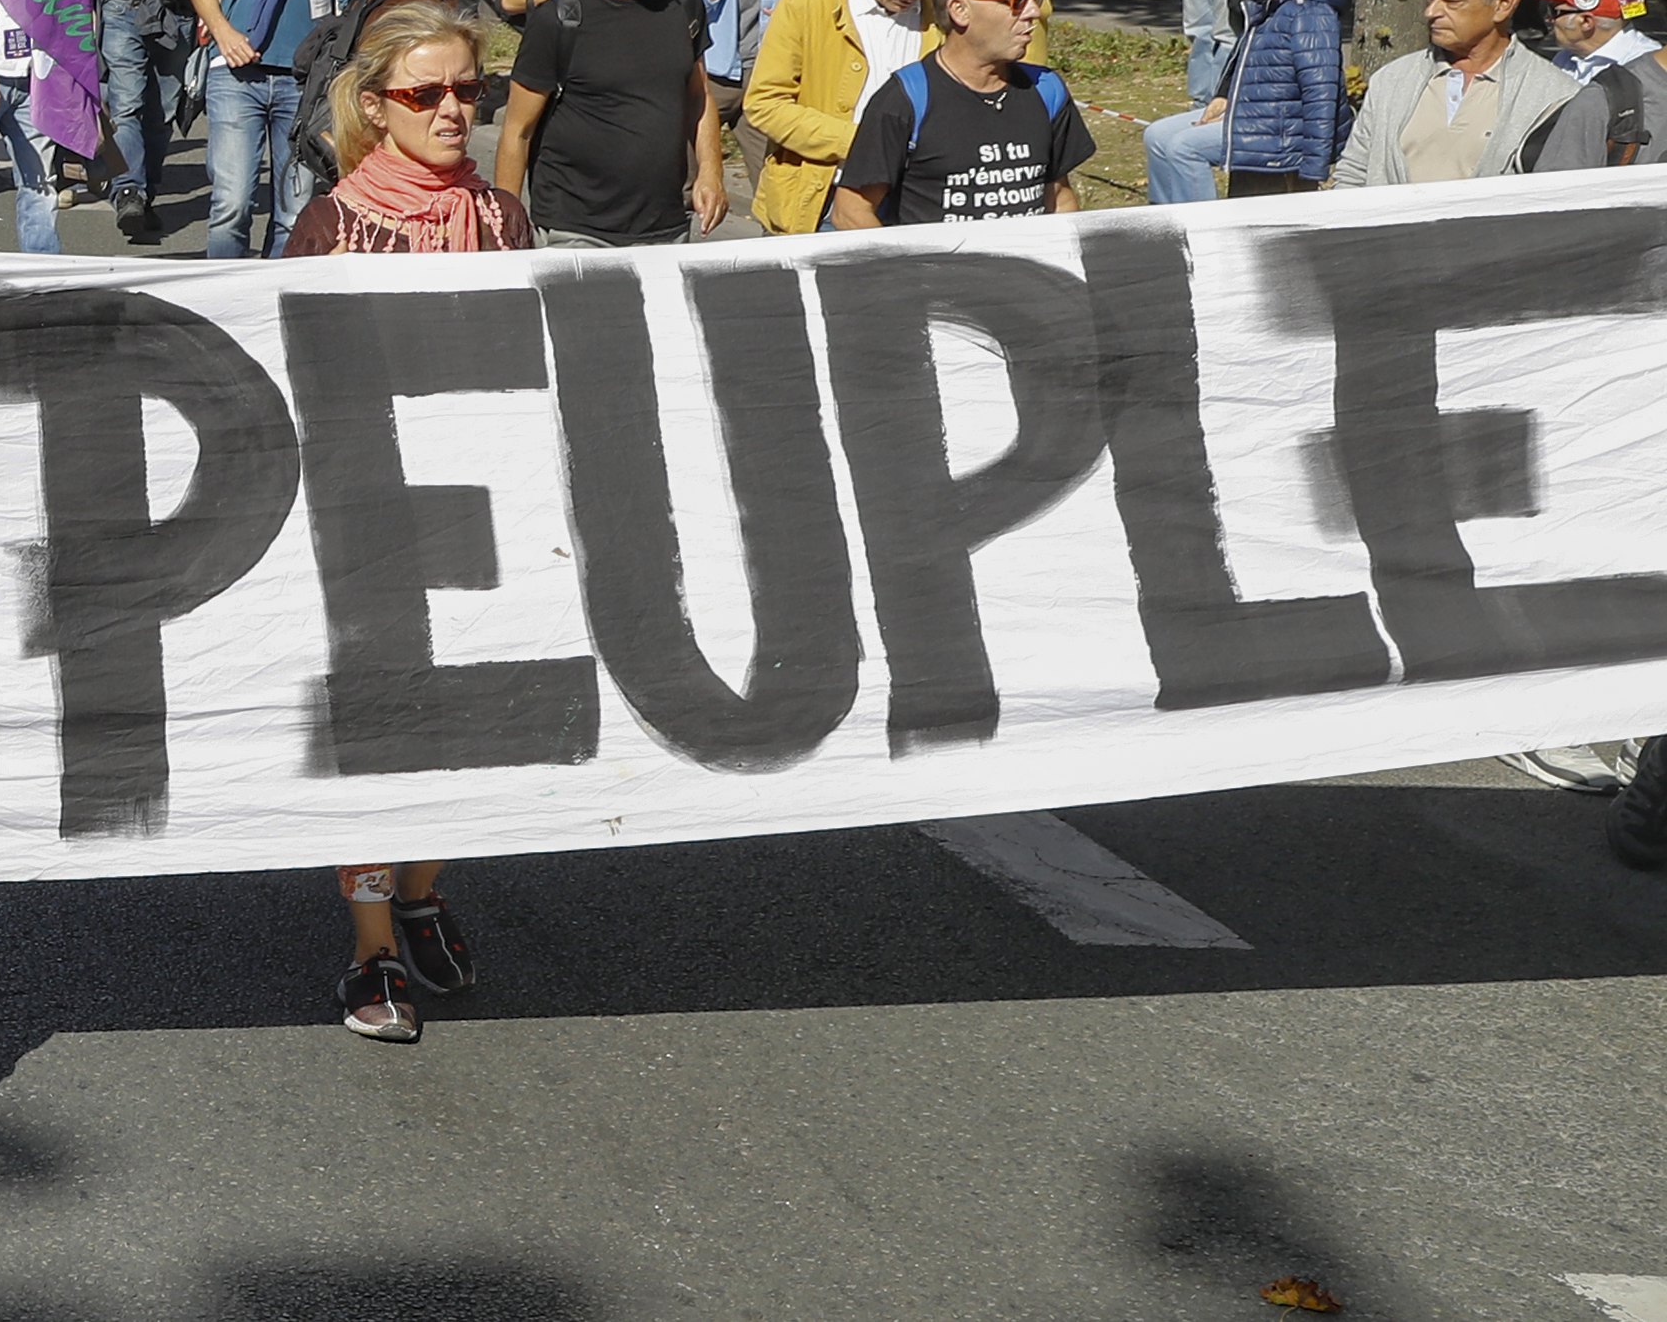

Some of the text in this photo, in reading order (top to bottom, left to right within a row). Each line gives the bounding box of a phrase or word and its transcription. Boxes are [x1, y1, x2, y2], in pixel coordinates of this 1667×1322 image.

[979, 142, 1030, 163] Si tu
[942, 188, 967, 209] je
